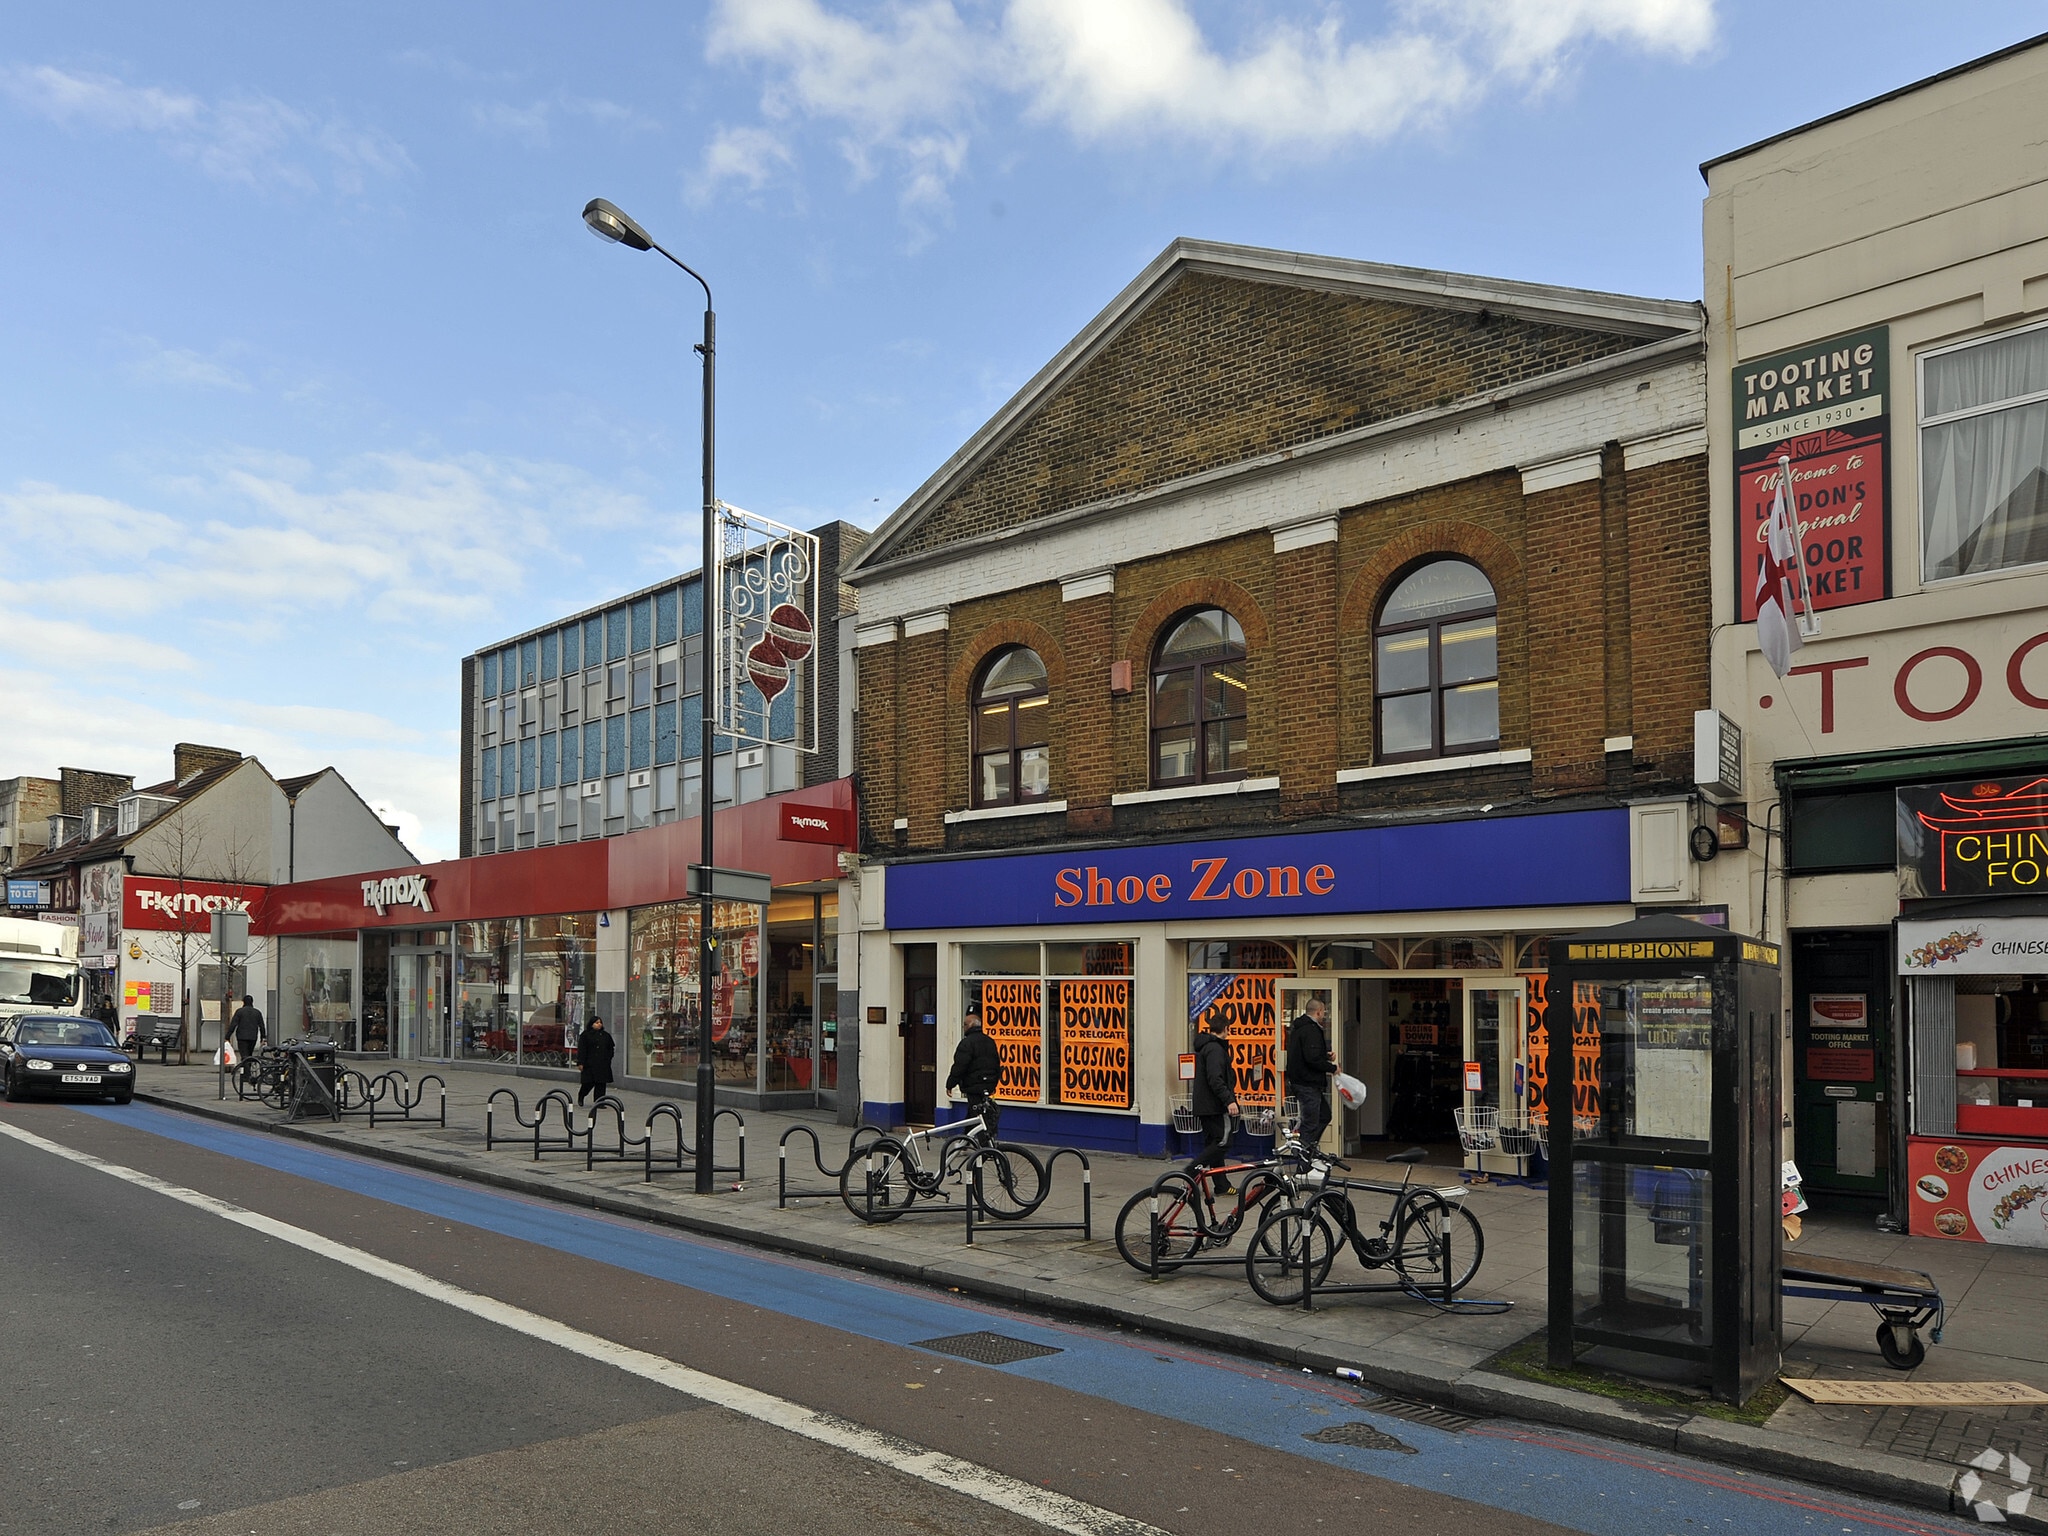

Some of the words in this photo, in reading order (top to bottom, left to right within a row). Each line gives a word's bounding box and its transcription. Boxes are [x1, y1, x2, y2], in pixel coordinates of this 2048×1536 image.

[1744, 344, 1874, 395] TOOTING
[1745, 368, 1874, 420] MARKET
[1765, 418, 1810, 438] SINCE
[1816, 407, 1852, 425] 1930
[1846, 454, 1865, 471] to
[1054, 866, 1173, 908] Shoe
[1187, 857, 1336, 902] Zone
[1987, 859, 2048, 887] FO
[10, 890, 21, 898] TO
[22, 890, 37, 898] LET
[41, 914, 76, 922] FASHION
[1085, 948, 1124, 961] CLOSING
[1579, 942, 1700, 959] TELEPHONE
[1063, 983, 1126, 1005] CLOSING
[986, 1005, 1041, 1028] DOWN
[1063, 1006, 1126, 1029] DOWN
[986, 1028, 997, 1036] TO
[1064, 1029, 1076, 1039] TO
[1079, 1030, 1126, 1040] RELOCATE
[1404, 1025, 1433, 1033] CLOSING
[1404, 1032, 1433, 1041] DOWN
[1811, 1033, 1841, 1041] TOOTING
[1842, 1034, 1869, 1042] MARKET
[1000, 1043, 1041, 1065] OSING
[1828, 1041, 1852, 1049] OFFICE
[1064, 1044, 1126, 1068] CLOSING
[1000, 1065, 1041, 1088] OWN
[1064, 1067, 1126, 1092] DOWN
[1064, 1090, 1076, 1099] TO
[1079, 1092, 1126, 1103] RELOCATE
